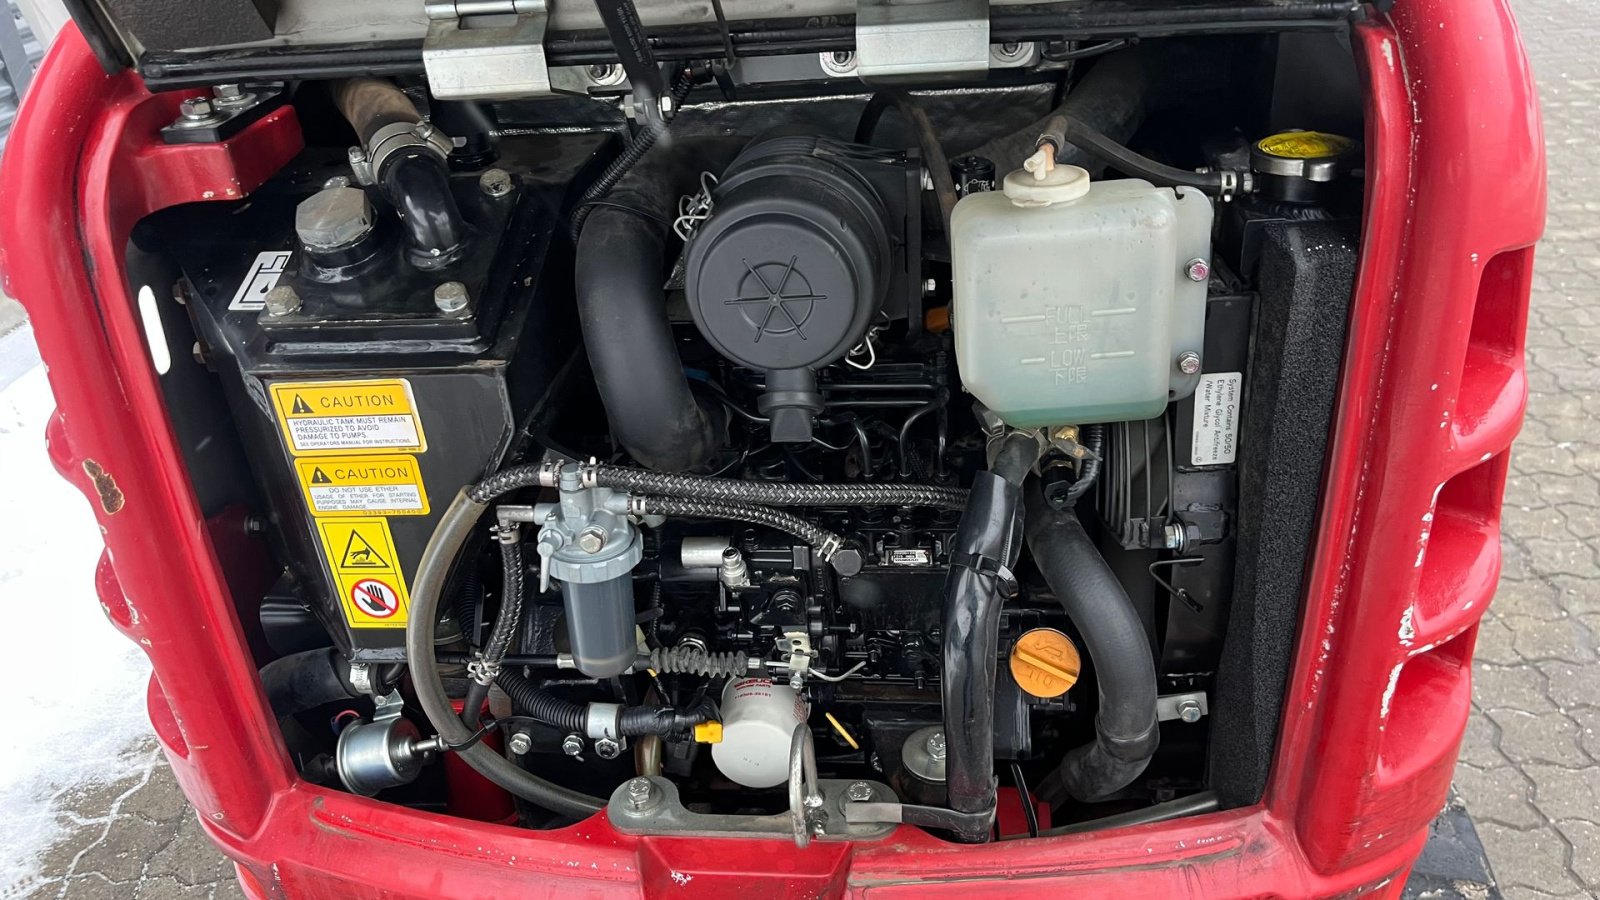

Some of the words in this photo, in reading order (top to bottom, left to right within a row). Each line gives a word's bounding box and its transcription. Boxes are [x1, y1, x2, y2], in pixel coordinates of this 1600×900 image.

[1045, 304, 1090, 326] FULL
[1050, 348, 1087, 368] LOW
[1214, 379, 1225, 406] Ethylene
[1226, 378, 1237, 402] System
[320, 394, 394, 408] CAUTION
[293, 418, 335, 426] HYDRAULIC
[335, 417, 355, 425] TANK
[378, 416, 407, 424] REMAIN
[1202, 404, 1212, 428] Mixture
[1212, 408, 1223, 428] Glycol
[1225, 404, 1235, 431] Contains
[295, 425, 344, 433] PRESSURIZED
[297, 432, 329, 440] DAMAGE
[1211, 430, 1221, 461] Antifreeze
[1223, 433, 1233, 455] 50/50
[334, 467, 409, 480] CAUTION
